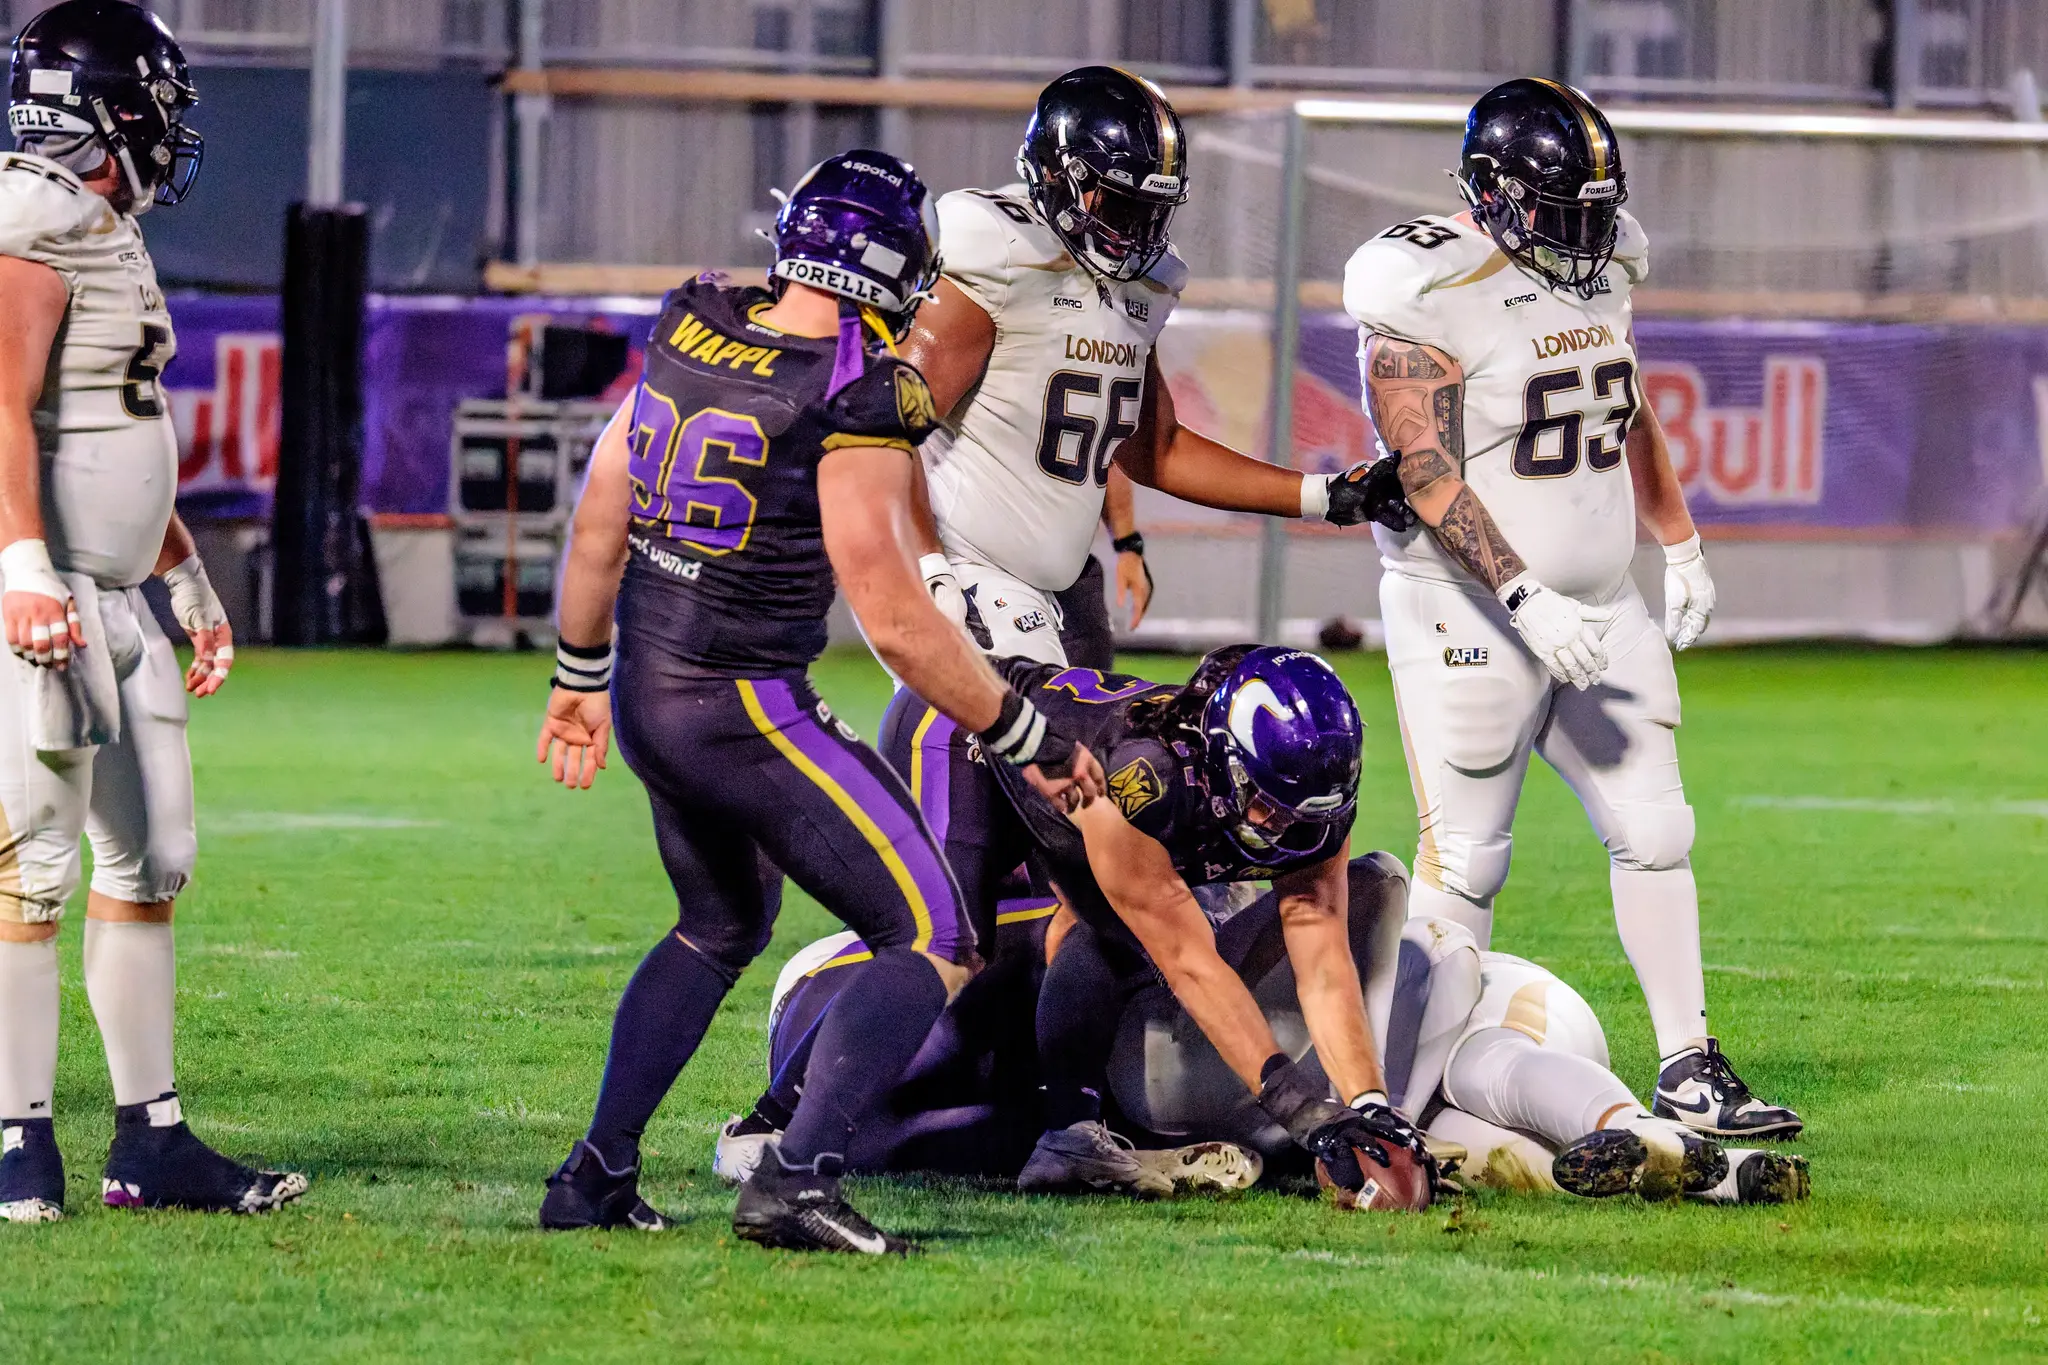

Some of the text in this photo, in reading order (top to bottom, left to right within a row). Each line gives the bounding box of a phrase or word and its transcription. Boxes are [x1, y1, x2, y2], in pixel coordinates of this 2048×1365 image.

[851, 162, 903, 188] spot.ai
[786, 261, 883, 304] FORELLE
[668, 312, 783, 377] WAPPL
[1065, 334, 1138, 368] LONDON
[1531, 324, 1615, 359] LONDON
[1510, 357, 1642, 480] 63
[1448, 648, 1488, 663] AFLE
